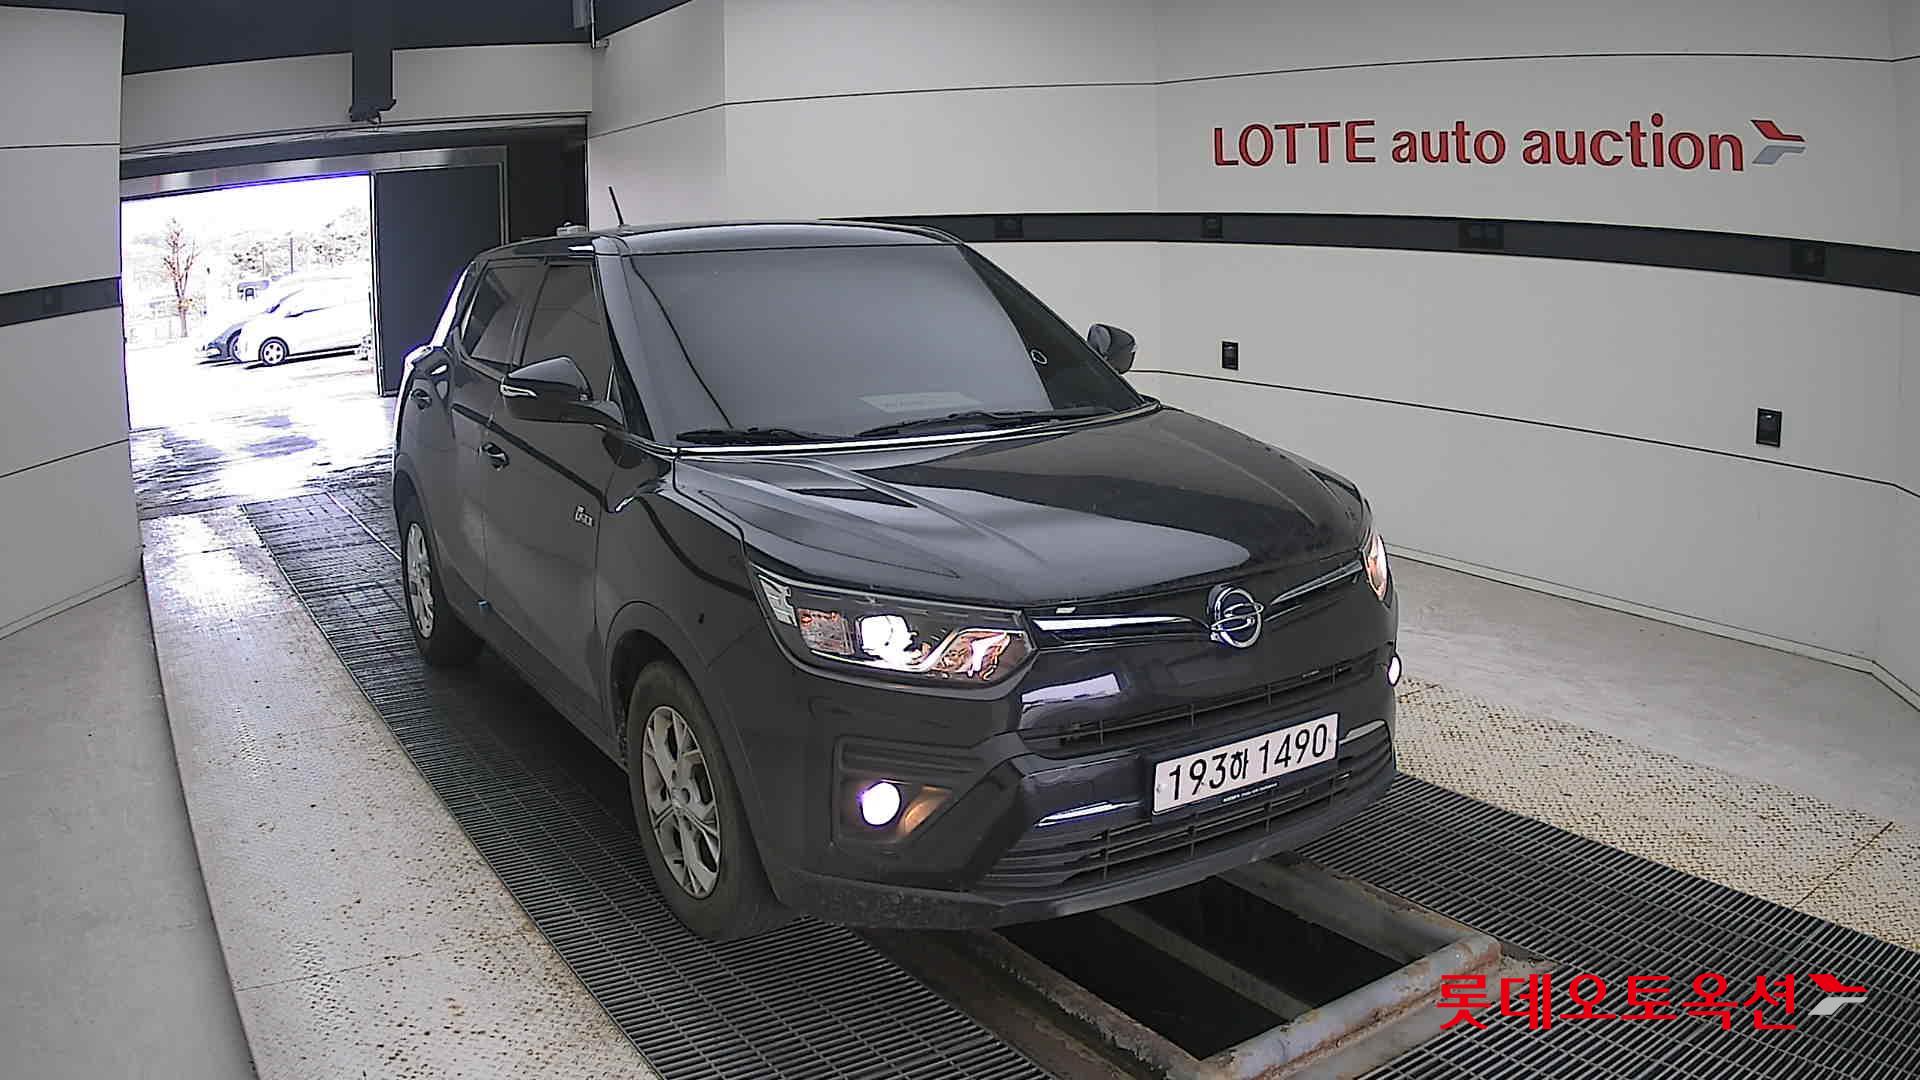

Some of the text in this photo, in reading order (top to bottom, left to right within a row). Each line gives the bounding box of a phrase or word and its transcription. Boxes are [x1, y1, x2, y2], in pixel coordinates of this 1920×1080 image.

[1213, 113, 1745, 172] LOTTE auto auction
[1169, 748, 1249, 801] 193하
[1258, 723, 1328, 774] 1490
